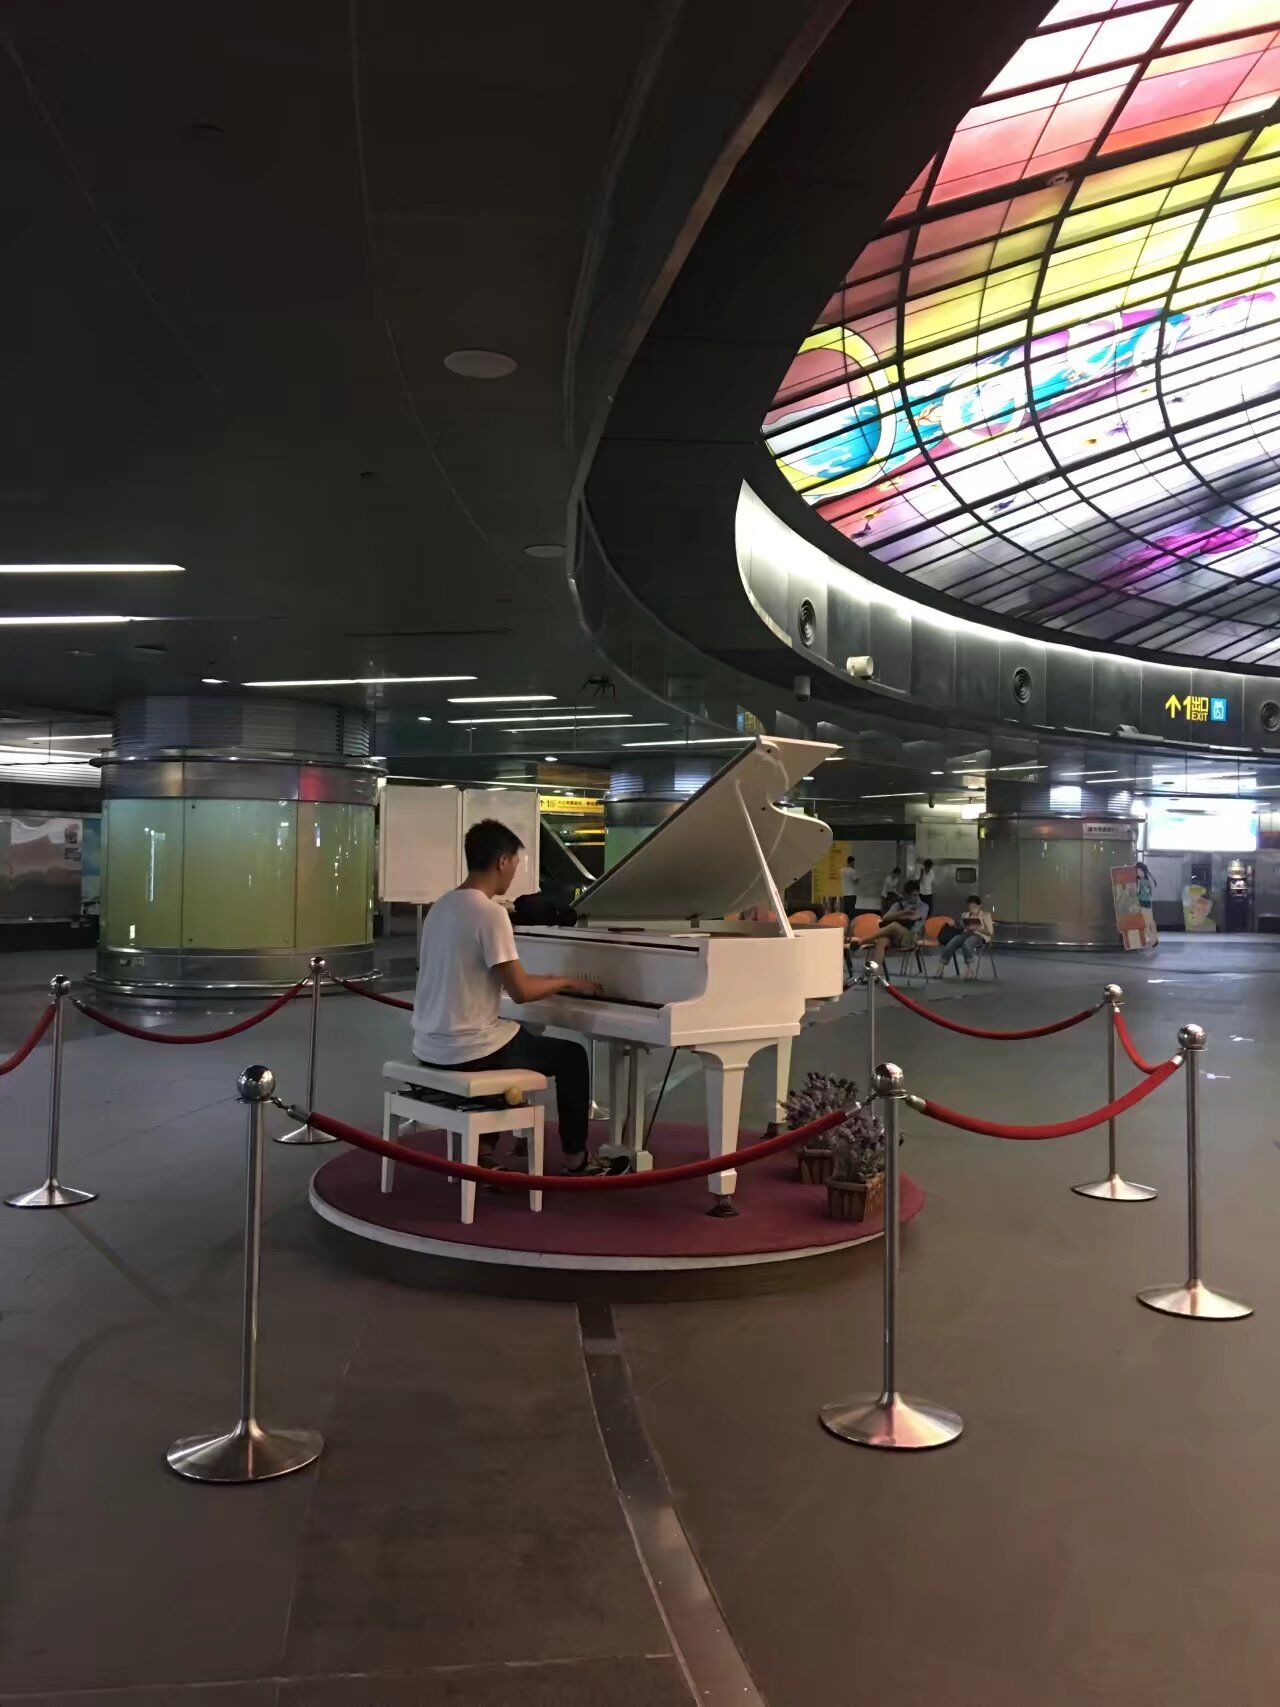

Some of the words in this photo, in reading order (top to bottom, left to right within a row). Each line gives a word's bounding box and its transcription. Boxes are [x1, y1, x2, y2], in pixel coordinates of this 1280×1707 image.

[1183, 696, 1191, 720] 1
[1192, 696, 1208, 712] 出口
[1192, 712, 1208, 721] EXIT
